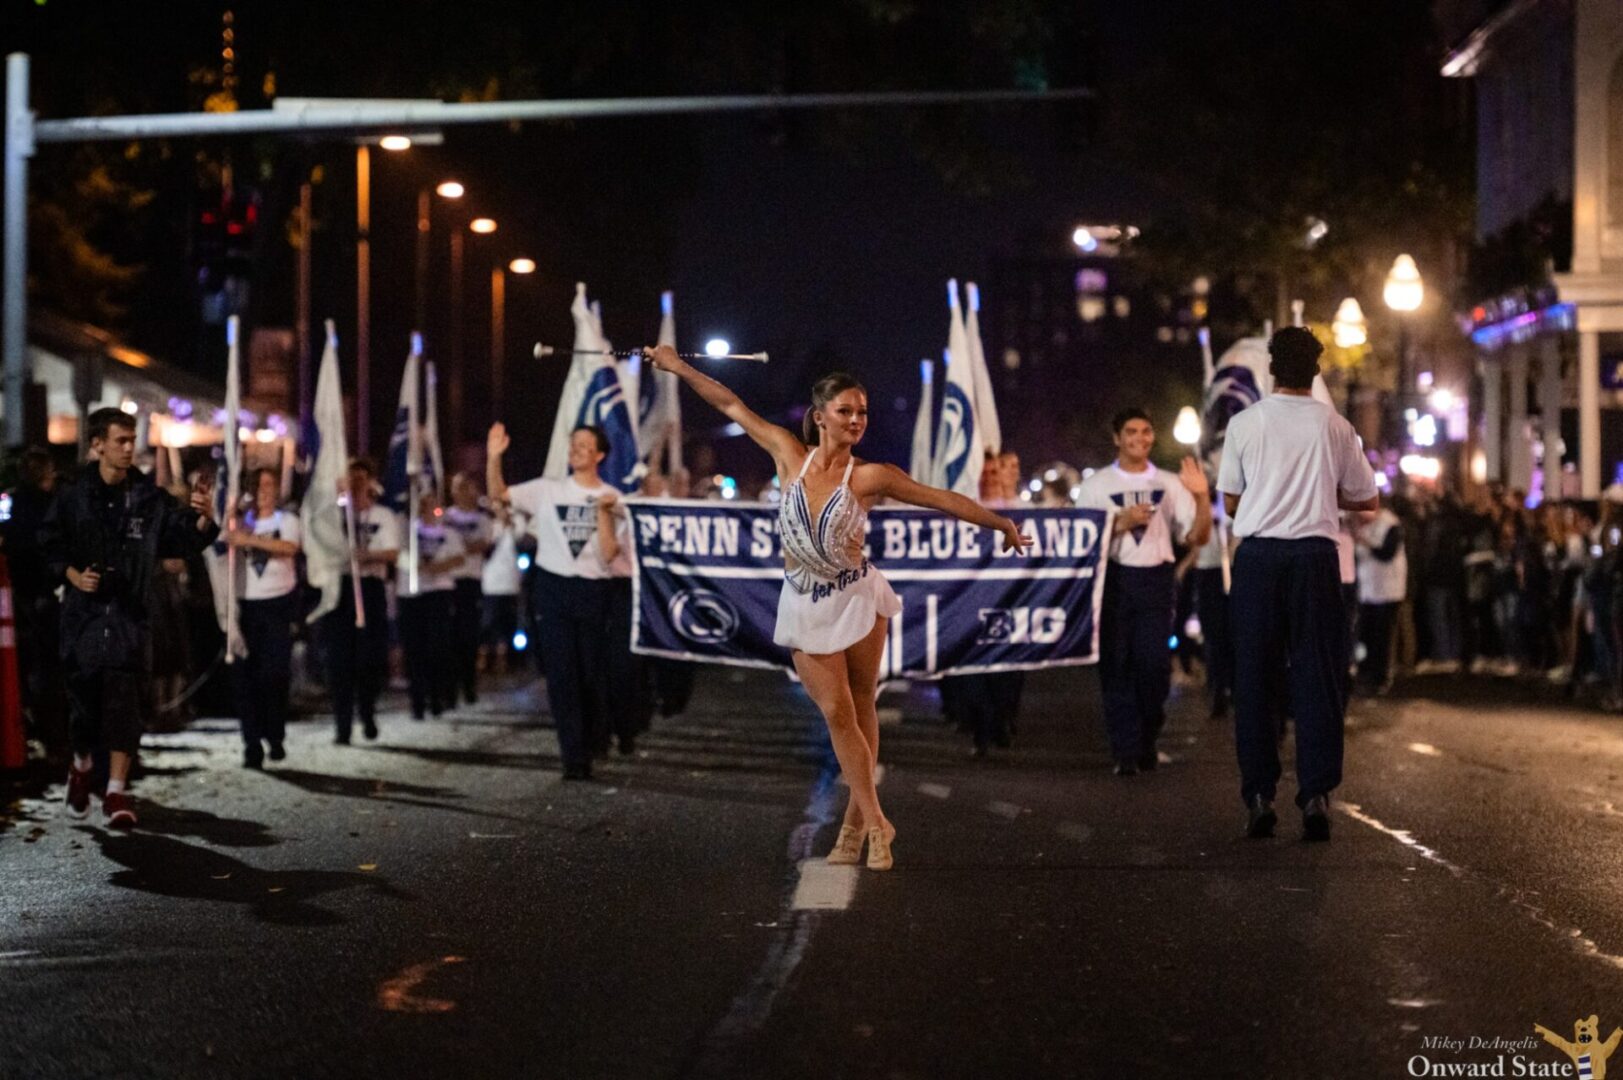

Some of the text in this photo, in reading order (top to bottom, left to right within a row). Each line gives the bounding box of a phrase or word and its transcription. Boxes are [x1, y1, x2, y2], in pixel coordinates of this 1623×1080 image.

[636, 514, 740, 557] PENN
[882, 519, 982, 559] BLUE
[812, 581, 836, 603] for
